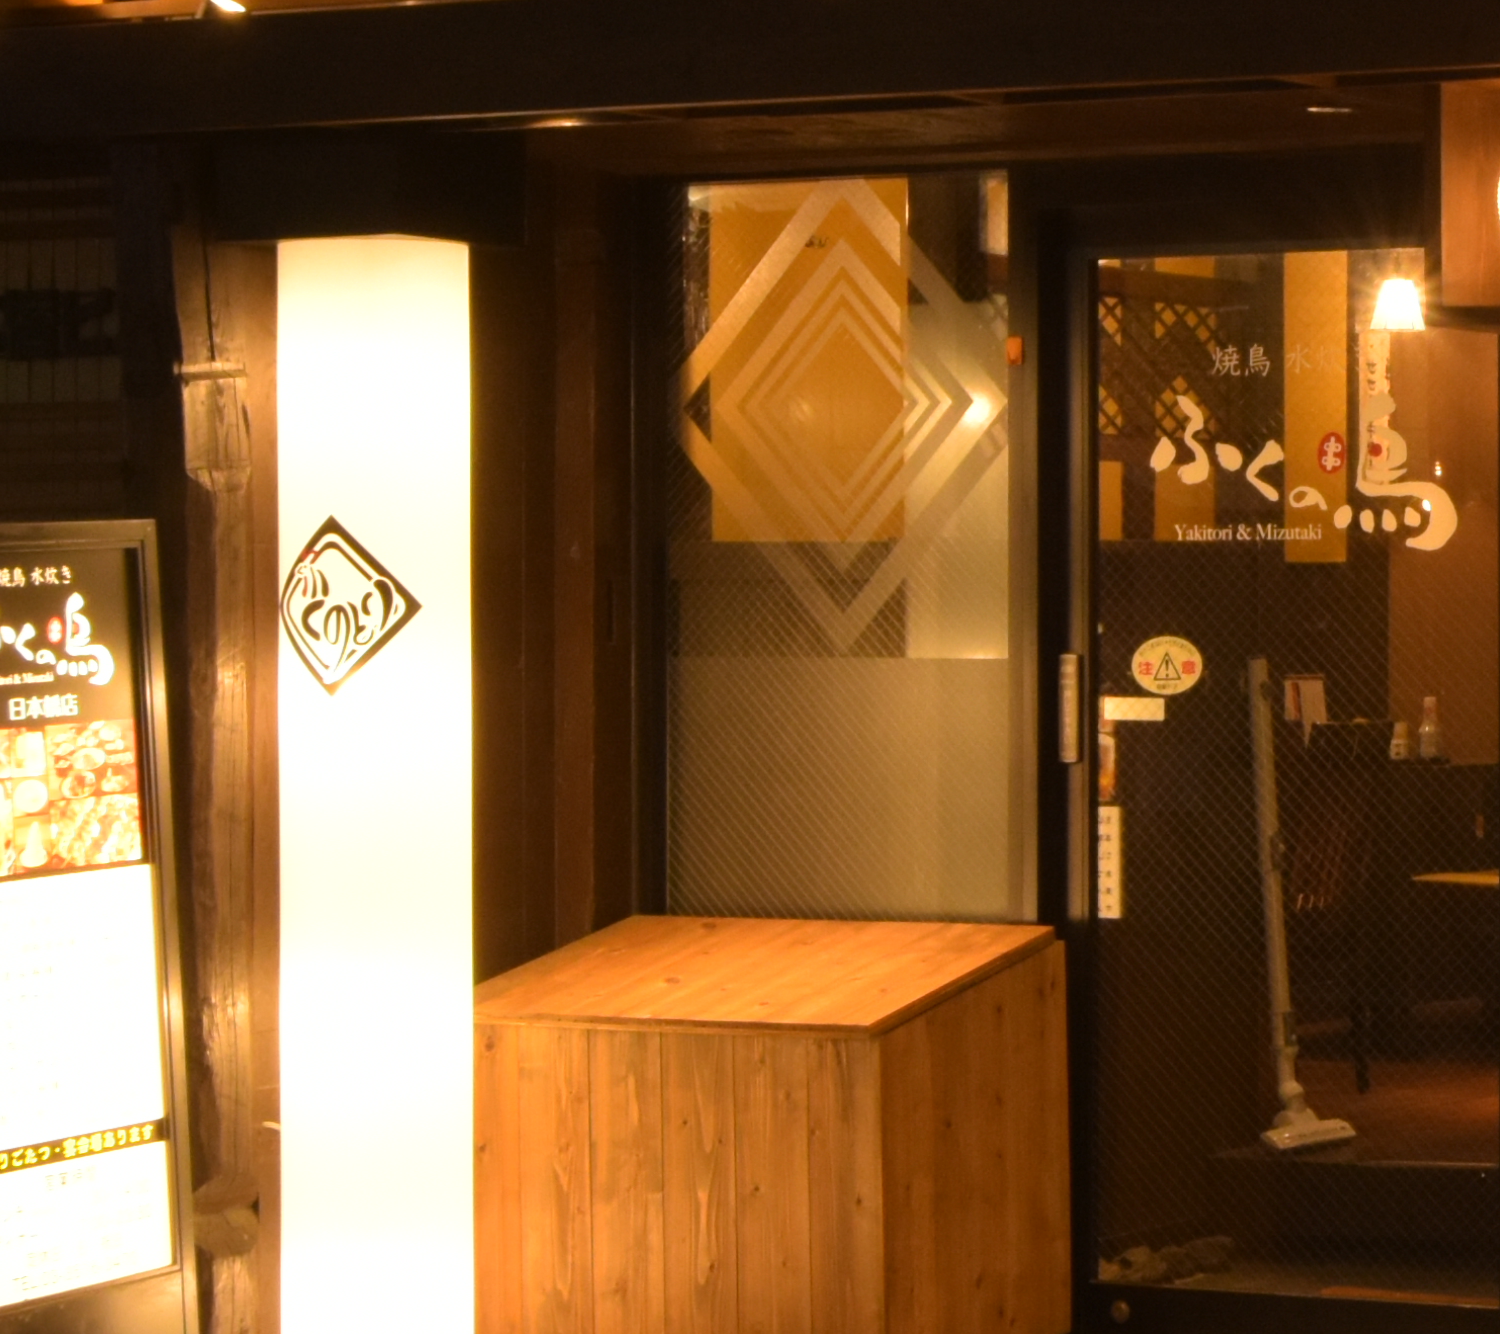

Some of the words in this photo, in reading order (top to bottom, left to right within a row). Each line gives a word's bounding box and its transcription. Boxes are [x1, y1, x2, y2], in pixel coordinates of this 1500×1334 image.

[1174, 523, 1233, 542] Yakitori
[1236, 524, 1253, 541] &
[1255, 523, 1322, 541] Mizutaki
